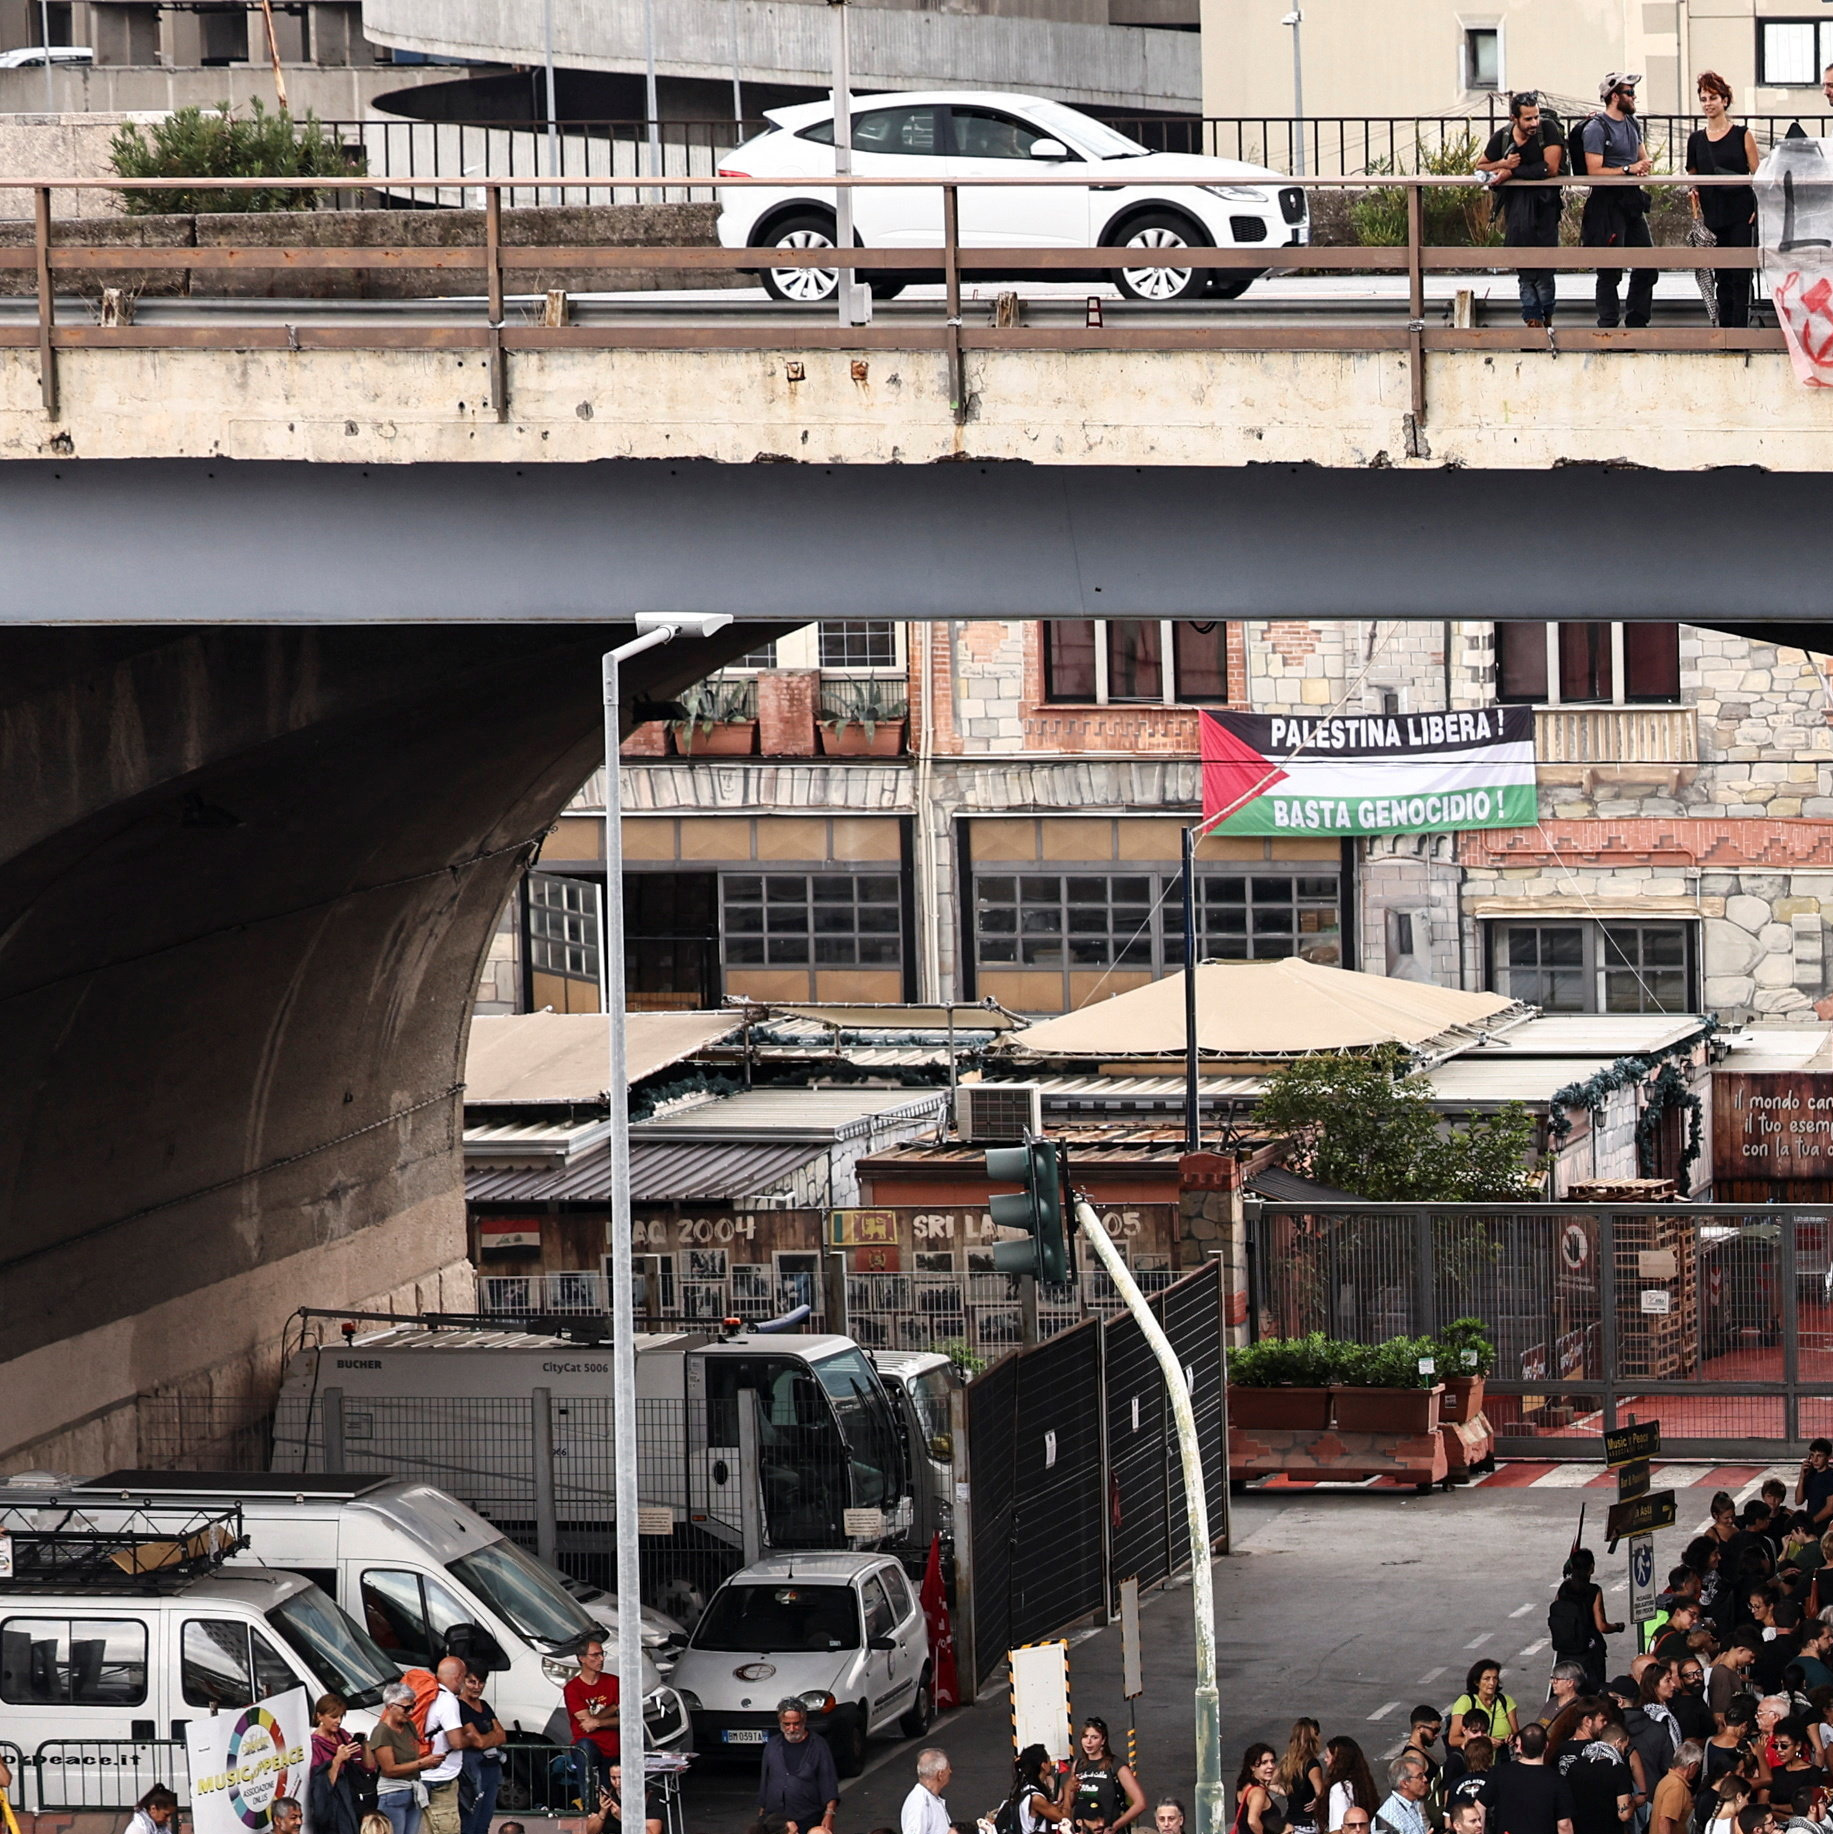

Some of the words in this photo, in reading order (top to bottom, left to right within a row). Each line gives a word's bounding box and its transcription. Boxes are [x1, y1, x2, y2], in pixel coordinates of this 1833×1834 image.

[1270, 715, 1403, 750] PALESTINA
[1407, 711, 1493, 748] LIBERA
[1273, 799, 1352, 829] BASTA
[1357, 790, 1491, 830] GENOCIDIO
[1748, 1094, 1805, 1111] mondo
[1758, 1119, 1786, 1134] tuo
[1742, 1144, 1771, 1157] con
[1774, 1141, 1791, 1156] la
[1795, 1141, 1824, 1157] tua
[605, 1219, 668, 1246] IAQ
[677, 1214, 758, 1245] 2004
[910, 1213, 957, 1241] SRI
[336, 1359, 383, 1370] BUCHER
[541, 1361, 584, 1375] CityCat
[584, 1362, 609, 1373] 5006
[197, 1769, 253, 1797] MUSIC
[262, 1744, 306, 1775] PEACE
